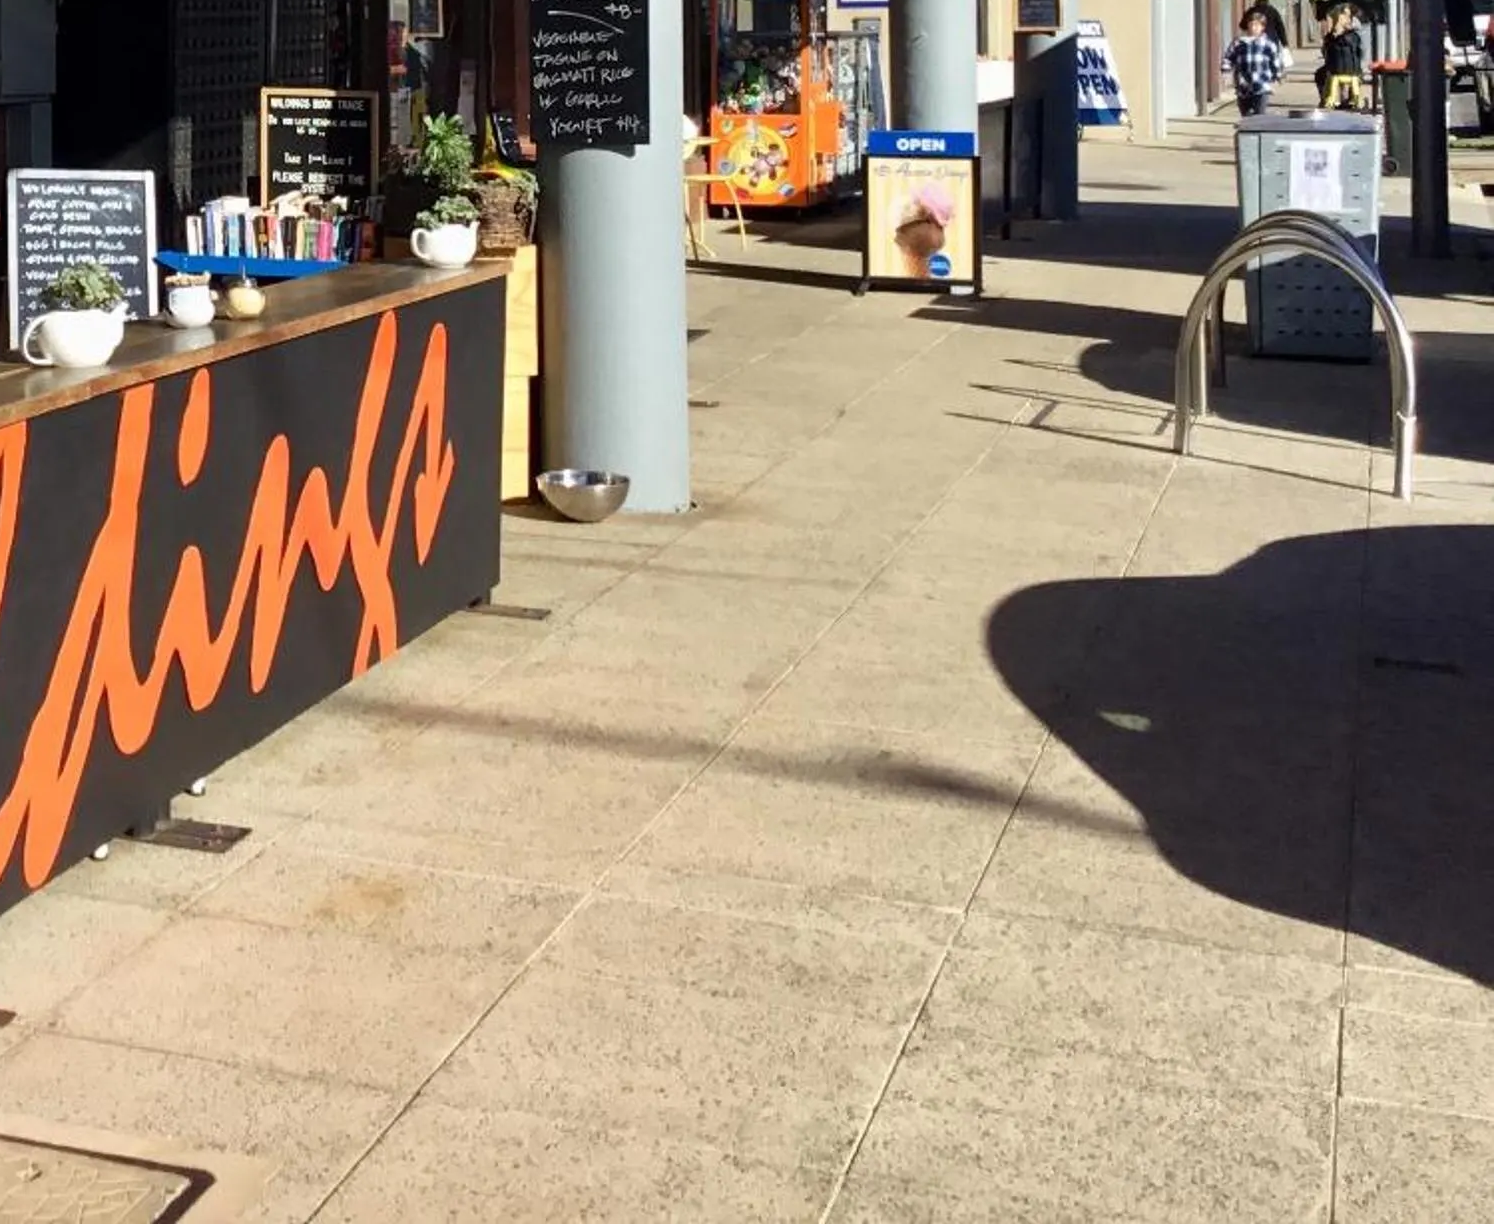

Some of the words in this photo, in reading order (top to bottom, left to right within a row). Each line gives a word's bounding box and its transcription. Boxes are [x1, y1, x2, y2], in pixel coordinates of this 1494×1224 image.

[596, 47, 619, 62] ON
[1077, 46, 1109, 70] OW
[1077, 73, 1120, 97] PEN
[896, 137, 947, 152] OPEN
